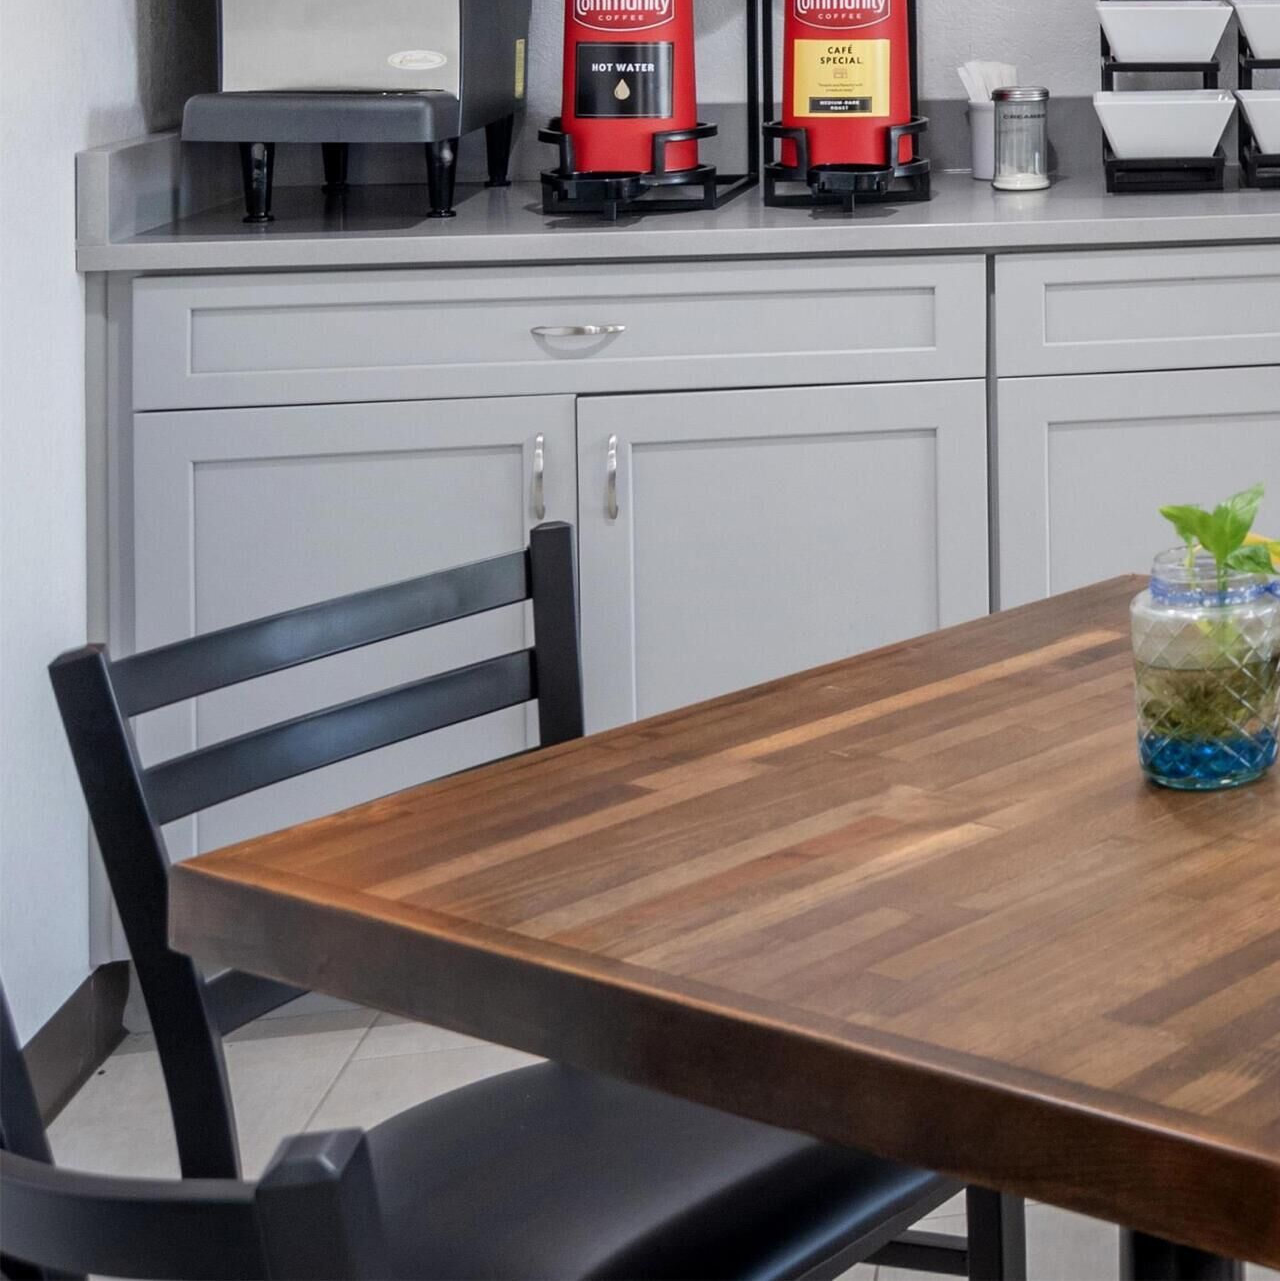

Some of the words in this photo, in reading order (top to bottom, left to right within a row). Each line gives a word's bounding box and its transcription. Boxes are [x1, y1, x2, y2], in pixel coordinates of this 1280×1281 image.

[827, 44, 853, 54] CAFÉ
[820, 56, 861, 64] SPECIAL
[591, 63, 613, 72] HOT
[615, 63, 655, 72] WATER
